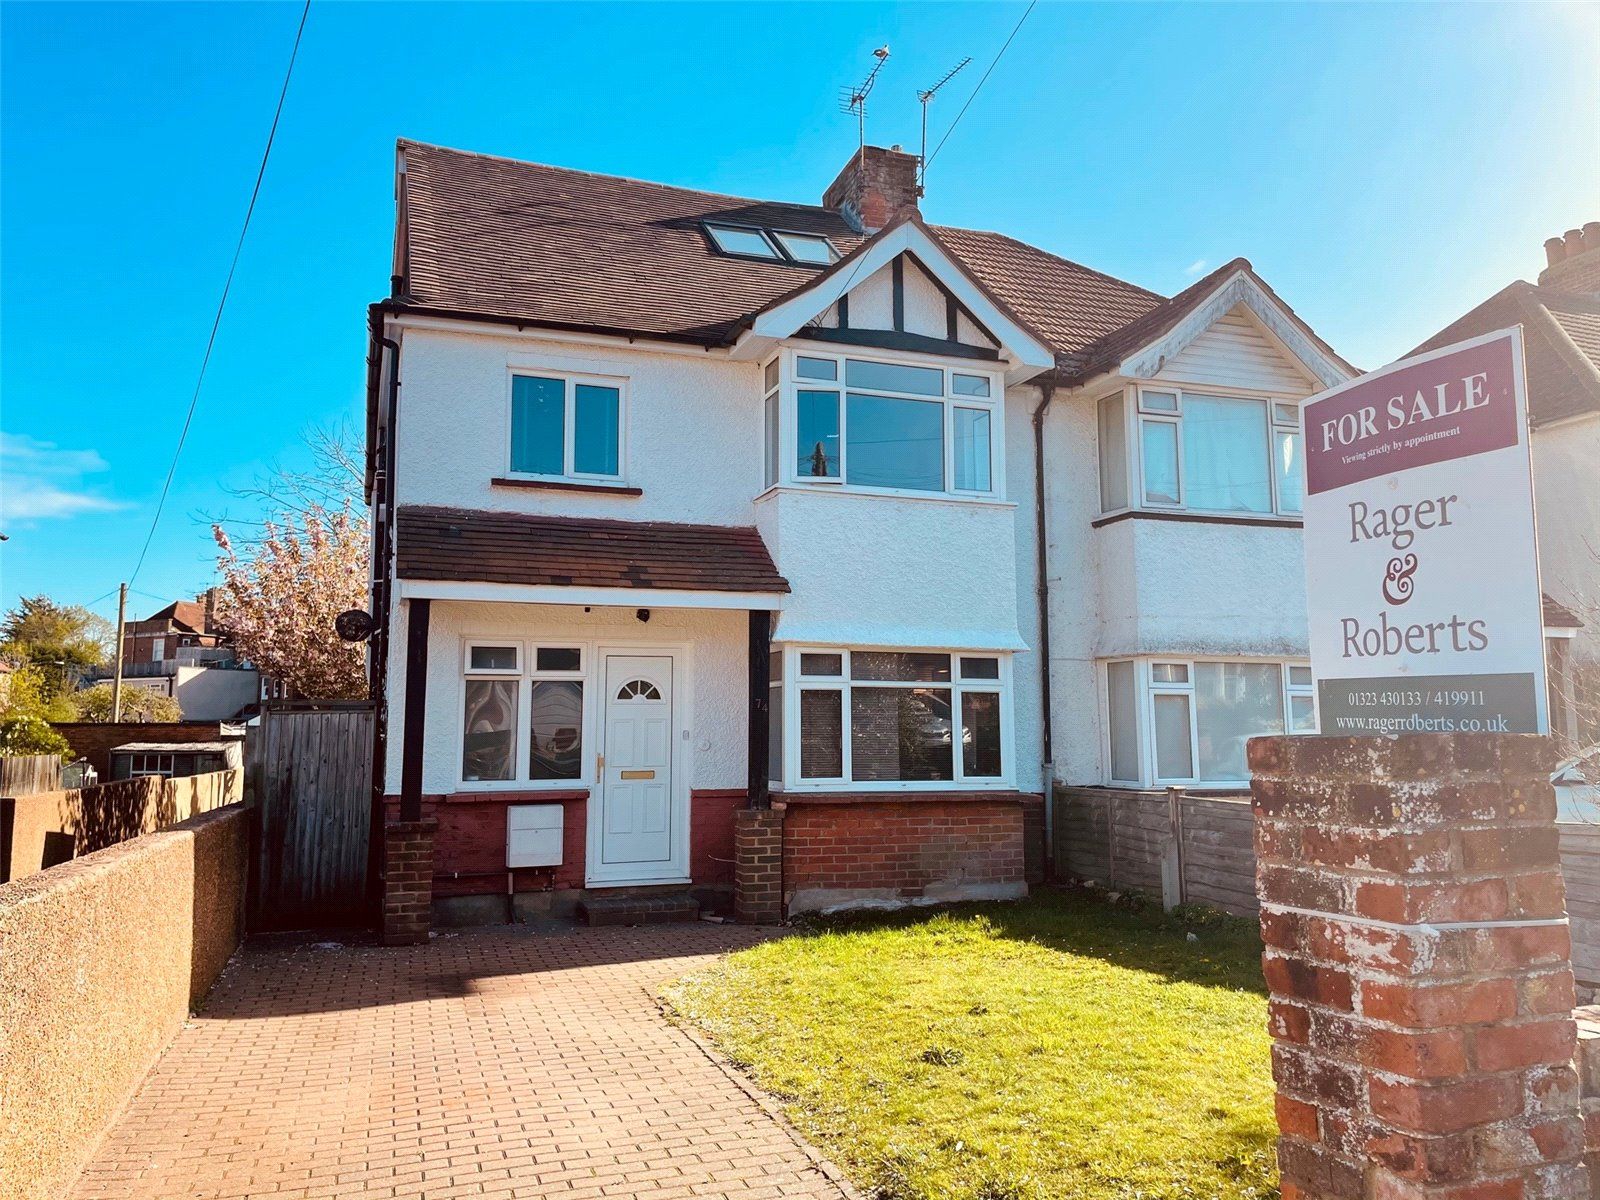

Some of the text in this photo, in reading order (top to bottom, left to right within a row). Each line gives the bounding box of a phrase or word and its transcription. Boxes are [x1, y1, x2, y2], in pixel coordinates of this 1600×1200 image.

[1321, 372, 1491, 453] FOR SALE
[1341, 426, 1461, 465] Viewing strictly by appointment
[1349, 494, 1458, 550] Rager
[1382, 553, 1418, 606] &
[1340, 611, 1489, 658] Roberts
[1348, 692, 1378, 706] 01323
[1380, 691, 1422, 706] 430133
[1434, 690, 1485, 706] 419911
